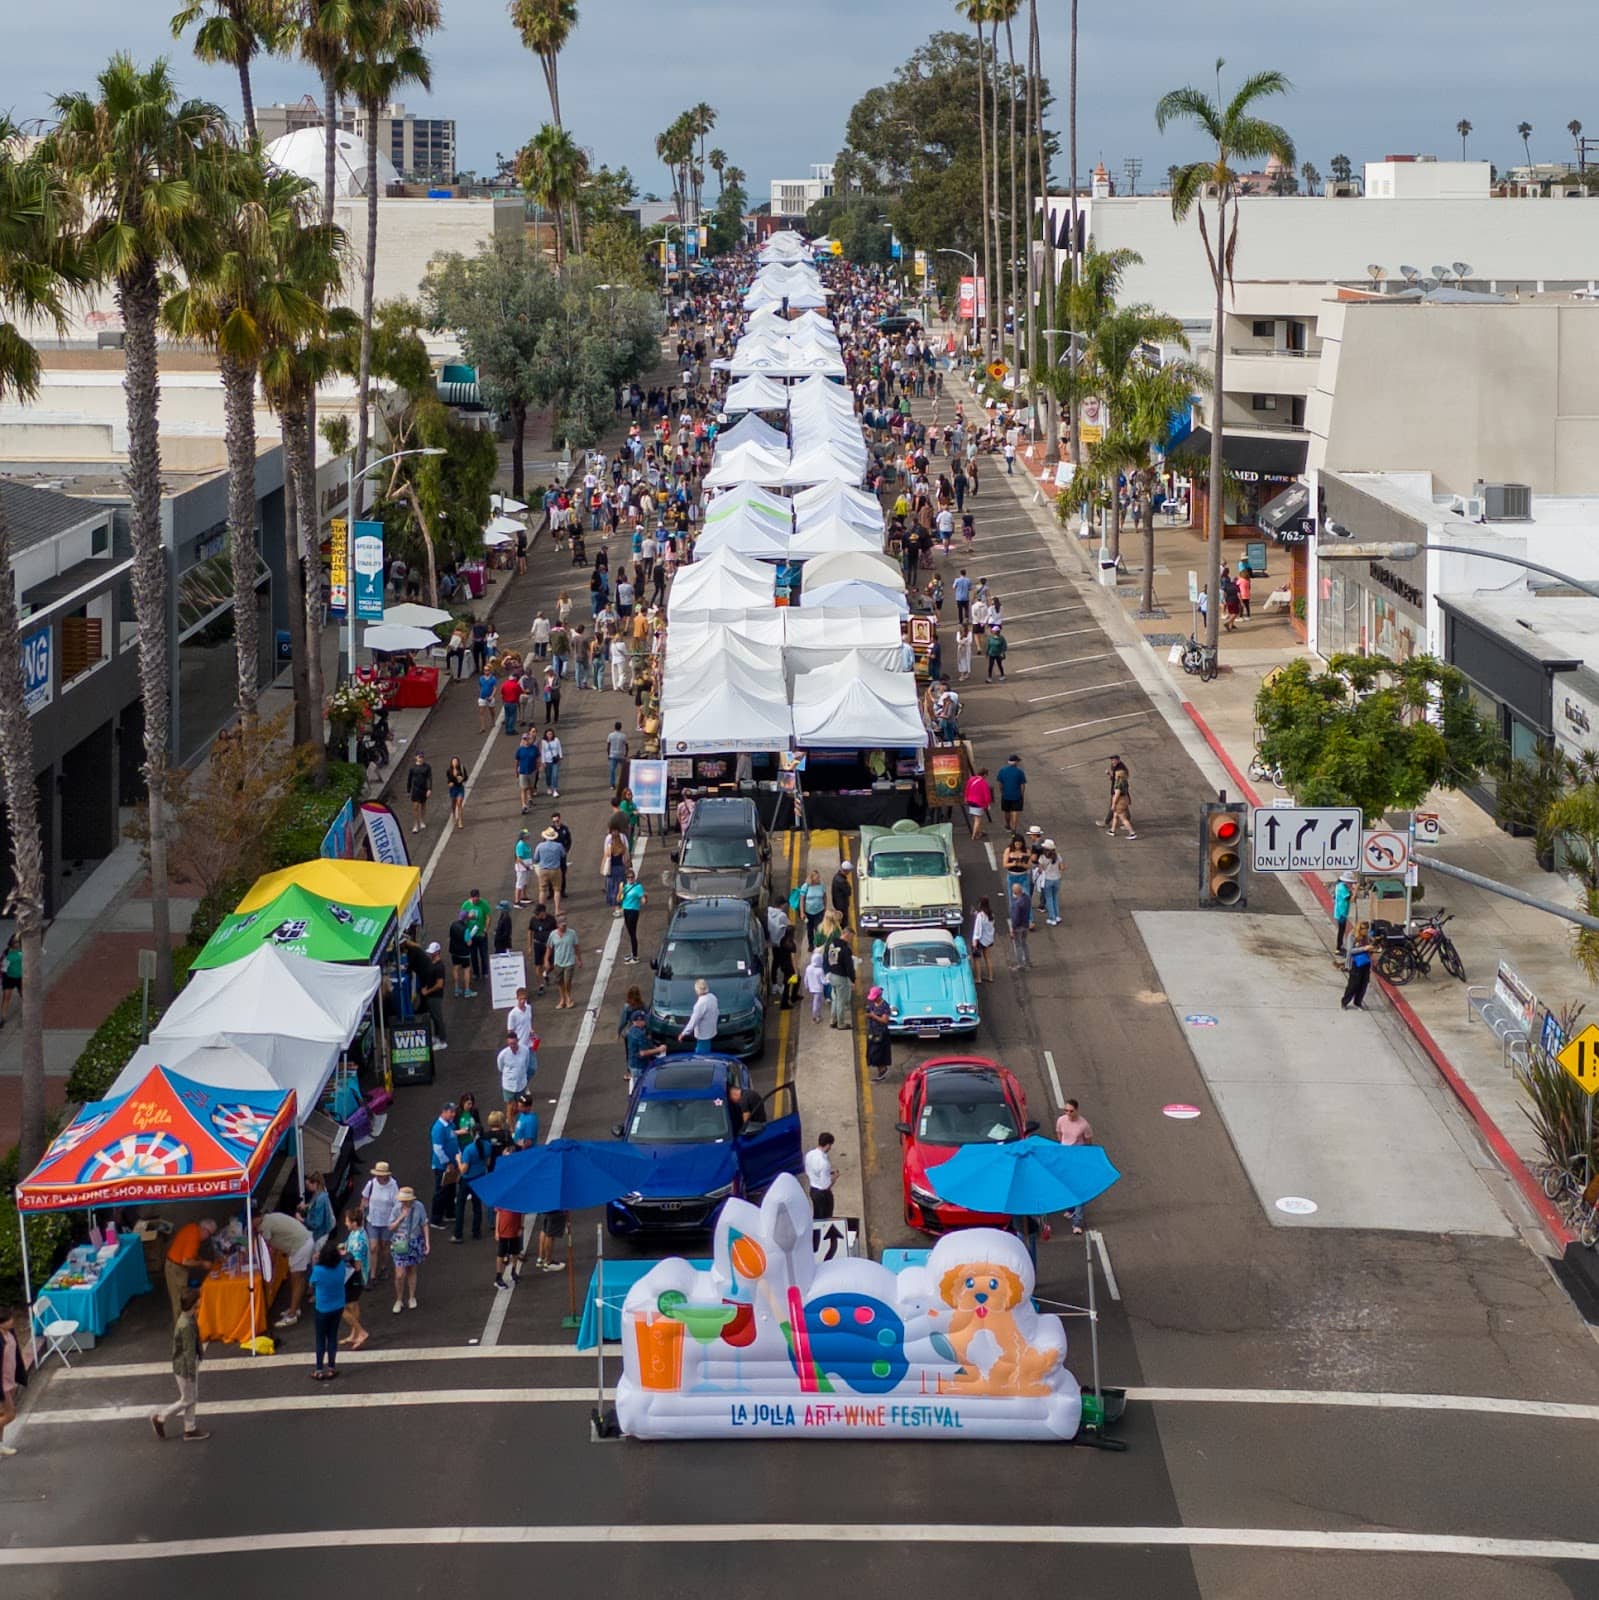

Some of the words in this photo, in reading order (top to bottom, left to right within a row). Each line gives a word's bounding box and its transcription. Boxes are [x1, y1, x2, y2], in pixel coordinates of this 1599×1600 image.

[1257, 856, 1286, 866] ONLY
[1292, 856, 1321, 866] ONLY
[1326, 856, 1355, 866] ONLY
[395, 1036, 427, 1049] WIN
[23, 1194, 50, 1206] STAY
[52, 1192, 79, 1204] PLAY
[82, 1188, 110, 1201] DINE
[111, 1184, 143, 1197] SHOP
[146, 1183, 168, 1195] ART
[171, 1182, 195, 1194] LIVE
[198, 1180, 228, 1192] LOVE
[731, 1403, 748, 1426] LA
[751, 1403, 796, 1426] JOLLA
[891, 1405, 964, 1428] FESTIVAL
